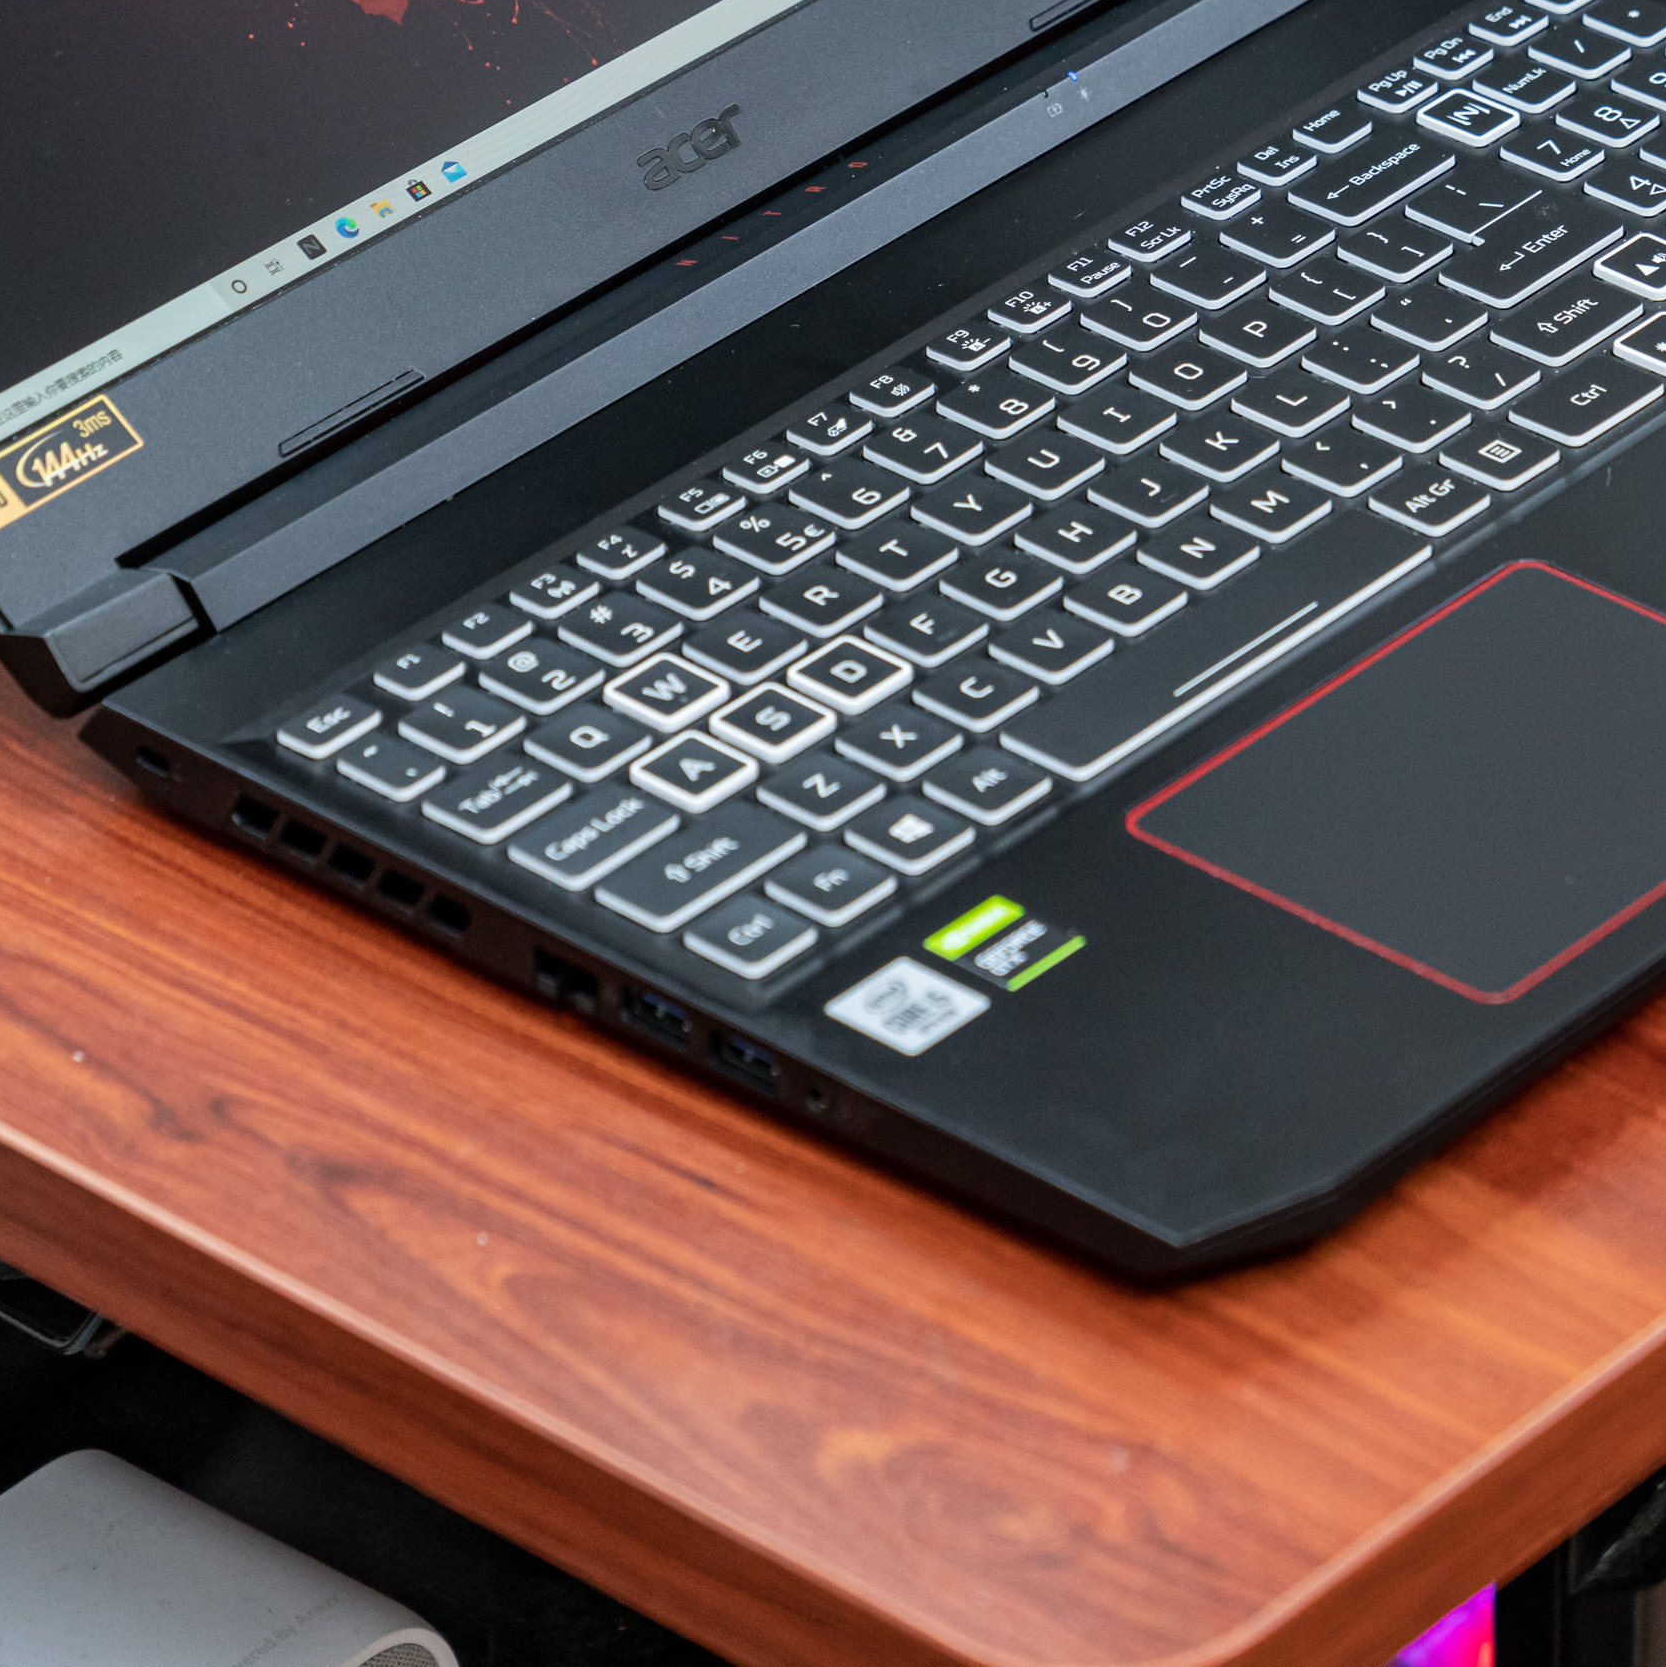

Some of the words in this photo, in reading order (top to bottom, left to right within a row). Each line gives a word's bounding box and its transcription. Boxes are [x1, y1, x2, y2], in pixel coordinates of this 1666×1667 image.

[1484, 5, 1514, 24] End
[1422, 46, 1449, 61] Pg
[1439, 36, 1464, 51] Dn
[1367, 78, 1394, 93] Pg
[1383, 68, 1409, 83] Up
[1501, 67, 1548, 95] NumLk
[1301, 109, 1342, 133] Home
[1592, 105, 1624, 123] 8
[636, 103, 741, 191] acer
[1252, 145, 1280, 162] Del
[1535, 138, 1563, 156] 7
[1559, 147, 1593, 168] Home
[1273, 154, 1301, 170] Ins
[1347, 142, 1422, 187] Backspace
[1190, 174, 1233, 200] PrtSc
[1628, 174, 1654, 192] 4
[1210, 182, 1257, 209] SysRq
[1123, 220, 1155, 238] F12
[1139, 234, 1165, 251] Scr
[1158, 225, 1183, 239] Lk
[1520, 223, 1569, 255] Enter
[1065, 256, 1095, 273] F11
[1078, 261, 1122, 286] Pause
[1003, 289, 1035, 309] F10
[1141, 311, 1172, 329] 0
[1552, 297, 1600, 326] Shift
[945, 328, 971, 344] F9
[1241, 319, 1269, 339] P
[1070, 353, 1102, 372] 9
[1172, 361, 1205, 381] O
[868, 374, 895, 390] F8
[998, 397, 1030, 416] 8
[1274, 393, 1309, 408] L
[1569, 383, 1608, 407] Ctrl
[72, 409, 113, 438] 3ms
[806, 410, 829, 428] F7
[1101, 405, 1133, 424] I
[922, 441, 950, 460] 7
[1203, 430, 1240, 452] K
[31, 440, 109, 487] 144Hz
[742, 449, 769, 466] F6
[1026, 448, 1061, 470] U
[678, 486, 705, 504] F5
[851, 486, 882, 506] 6
[1139, 476, 1162, 498] J
[1404, 493, 1438, 514] Alt
[1427, 477, 1456, 498] Gr
[952, 492, 984, 513] Y
[1249, 489, 1291, 515] M
[596, 533, 624, 552] F4
[774, 531, 808, 552] 5
[1056, 520, 1094, 544] H
[878, 538, 910, 558] T
[1179, 536, 1217, 560] N
[529, 572, 558, 591] F3
[707, 575, 733, 597] 4
[984, 567, 1018, 589] G
[803, 584, 840, 607] R
[1107, 583, 1143, 606] B
[462, 611, 490, 630] F2
[908, 612, 935, 636] F
[619, 621, 655, 644] 3
[726, 629, 763, 653] E
[1031, 628, 1065, 650] V
[395, 652, 421, 670] F1
[829, 659, 868, 684] D
[540, 668, 576, 692] 2
[641, 671, 687, 702] W
[958, 675, 995, 700] C
[305, 706, 351, 734] Esc
[464, 718, 497, 739] 1
[754, 705, 791, 732] S
[568, 724, 609, 750] Q
[879, 723, 918, 750] X
[678, 757, 716, 783] A
[971, 767, 1007, 794] Alt
[802, 772, 840, 799] Z
[458, 788, 503, 814] Tab
[544, 826, 599, 862] Caps
[589, 797, 644, 833] Lock
[683, 837, 737, 871] Shift
[813, 868, 848, 893] Fn
[728, 914, 772, 946] Ctrl
